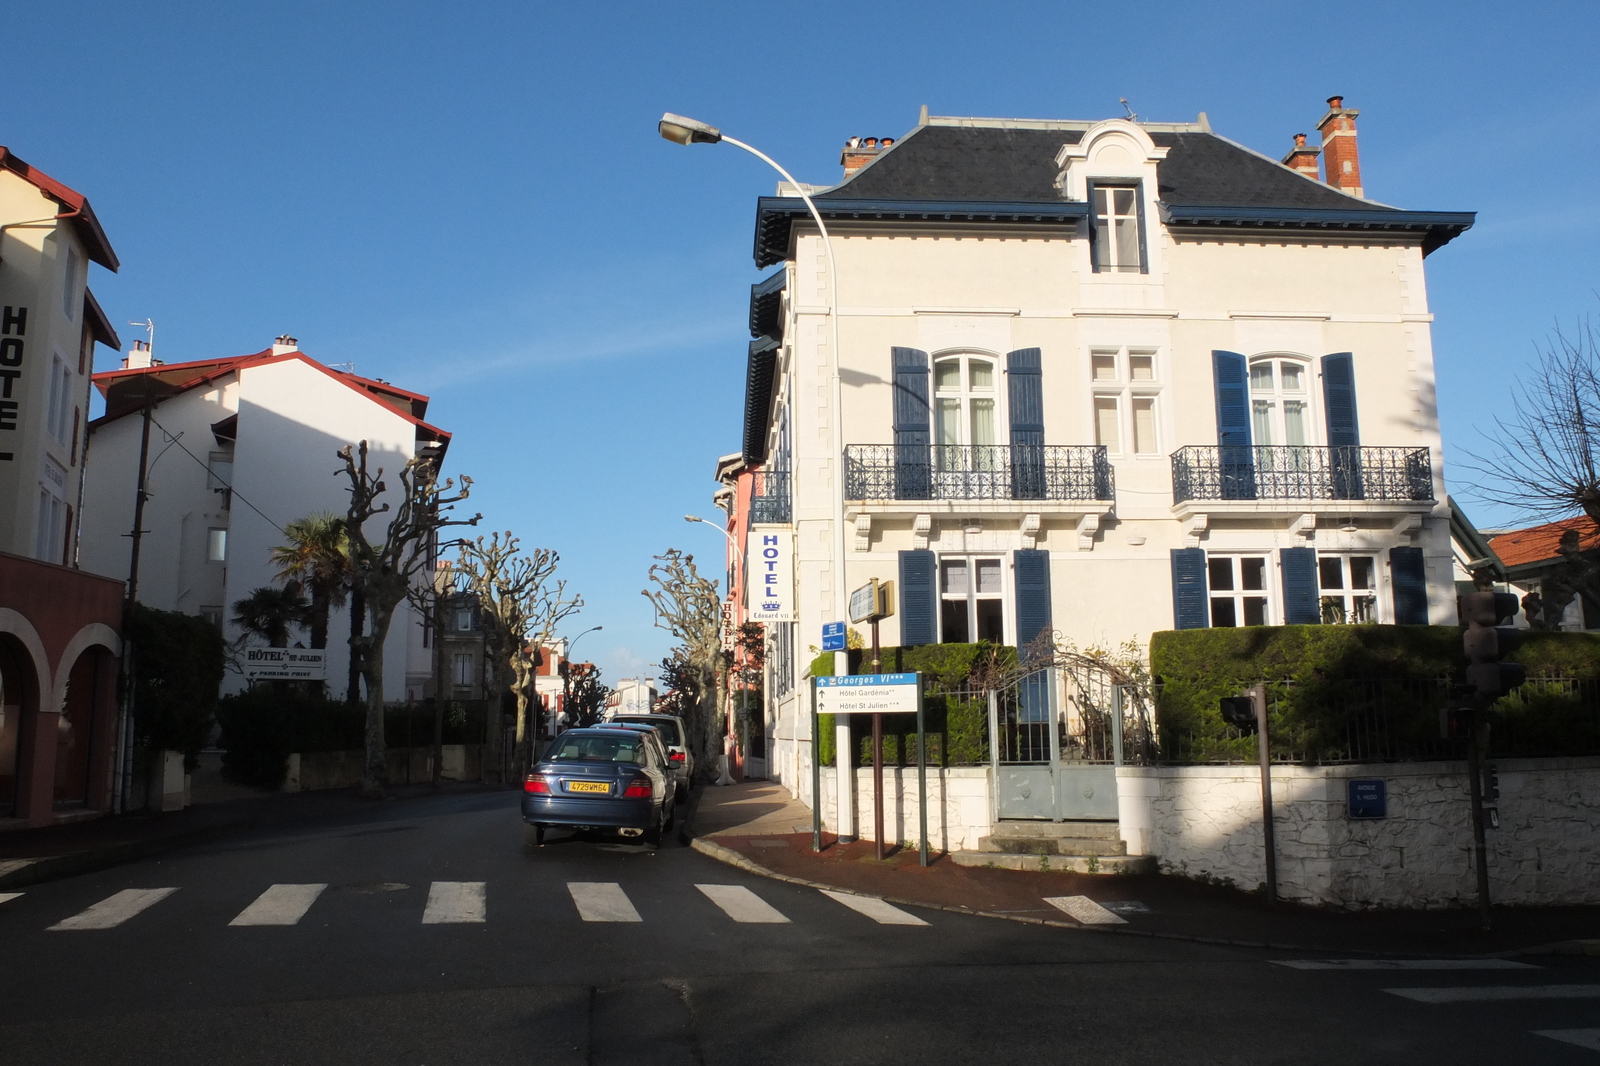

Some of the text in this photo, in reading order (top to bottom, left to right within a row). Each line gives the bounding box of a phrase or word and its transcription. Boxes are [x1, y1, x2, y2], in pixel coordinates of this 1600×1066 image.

[763, 535, 779, 598] HOTEL
[723, 603, 732, 645] HOTEL
[248, 649, 283, 661] HÔTEL
[837, 677, 874, 685] Georges
